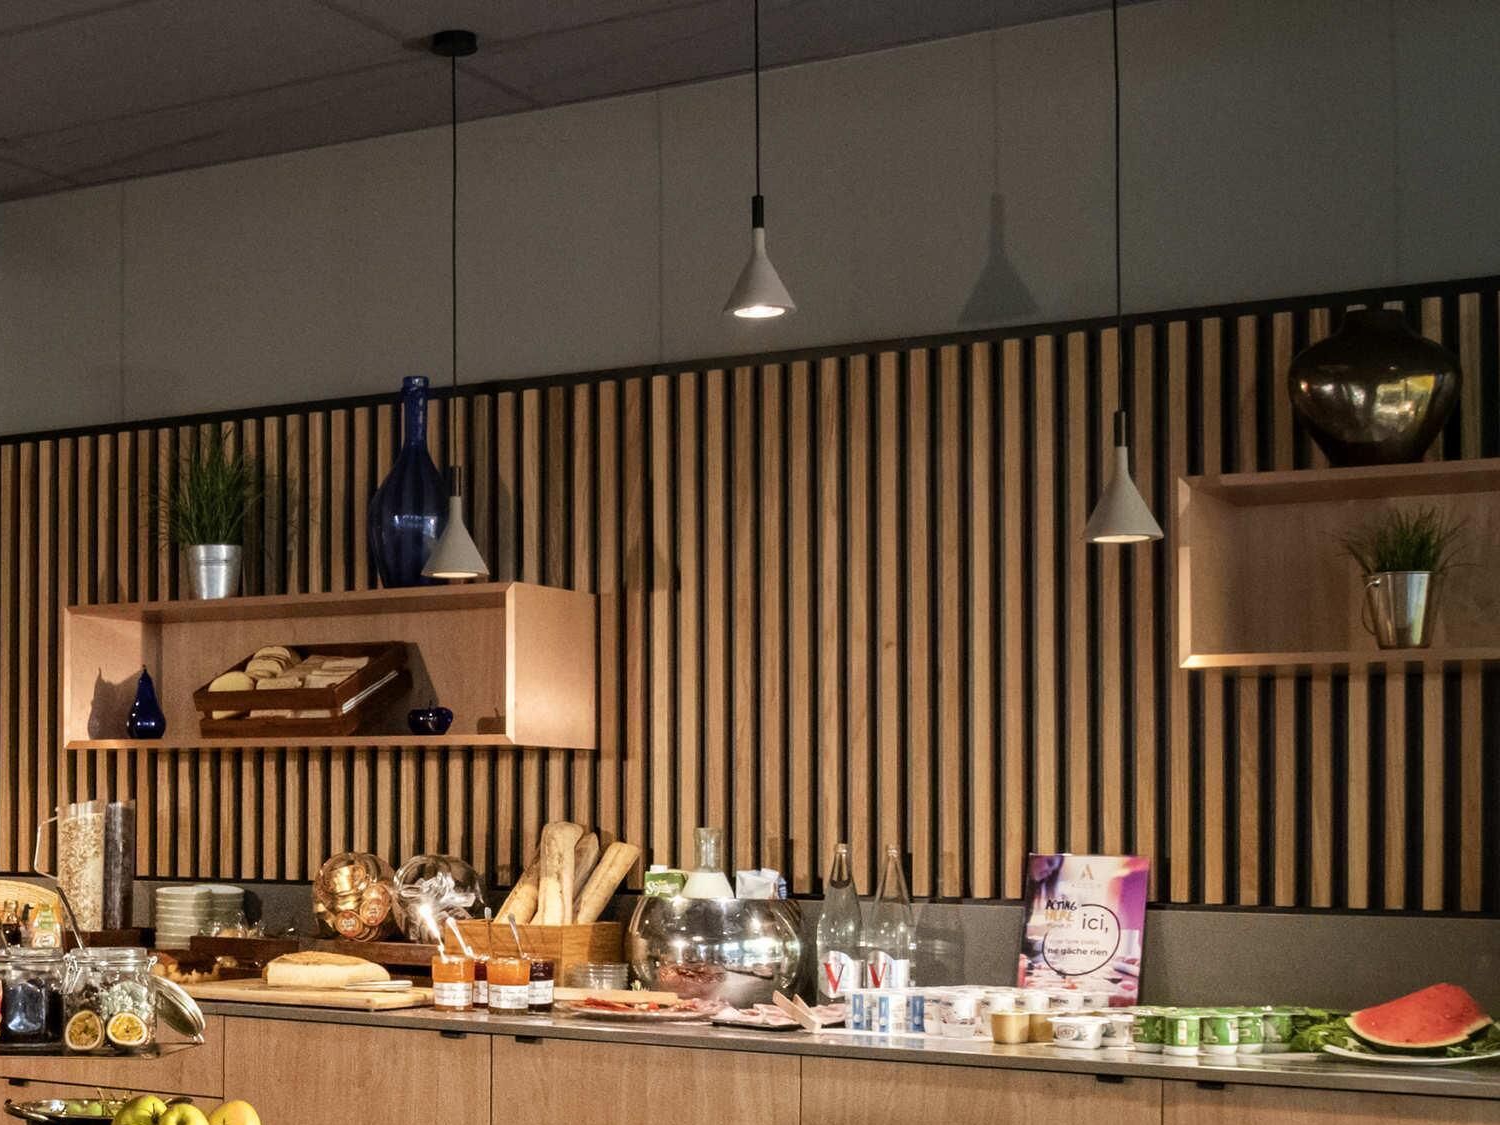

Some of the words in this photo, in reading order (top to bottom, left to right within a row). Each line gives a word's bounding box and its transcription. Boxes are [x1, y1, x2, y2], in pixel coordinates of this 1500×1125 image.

[1082, 913, 1109, 934] ici,
[1060, 947, 1088, 956] gâche
[1090, 948, 1108, 957] rien
